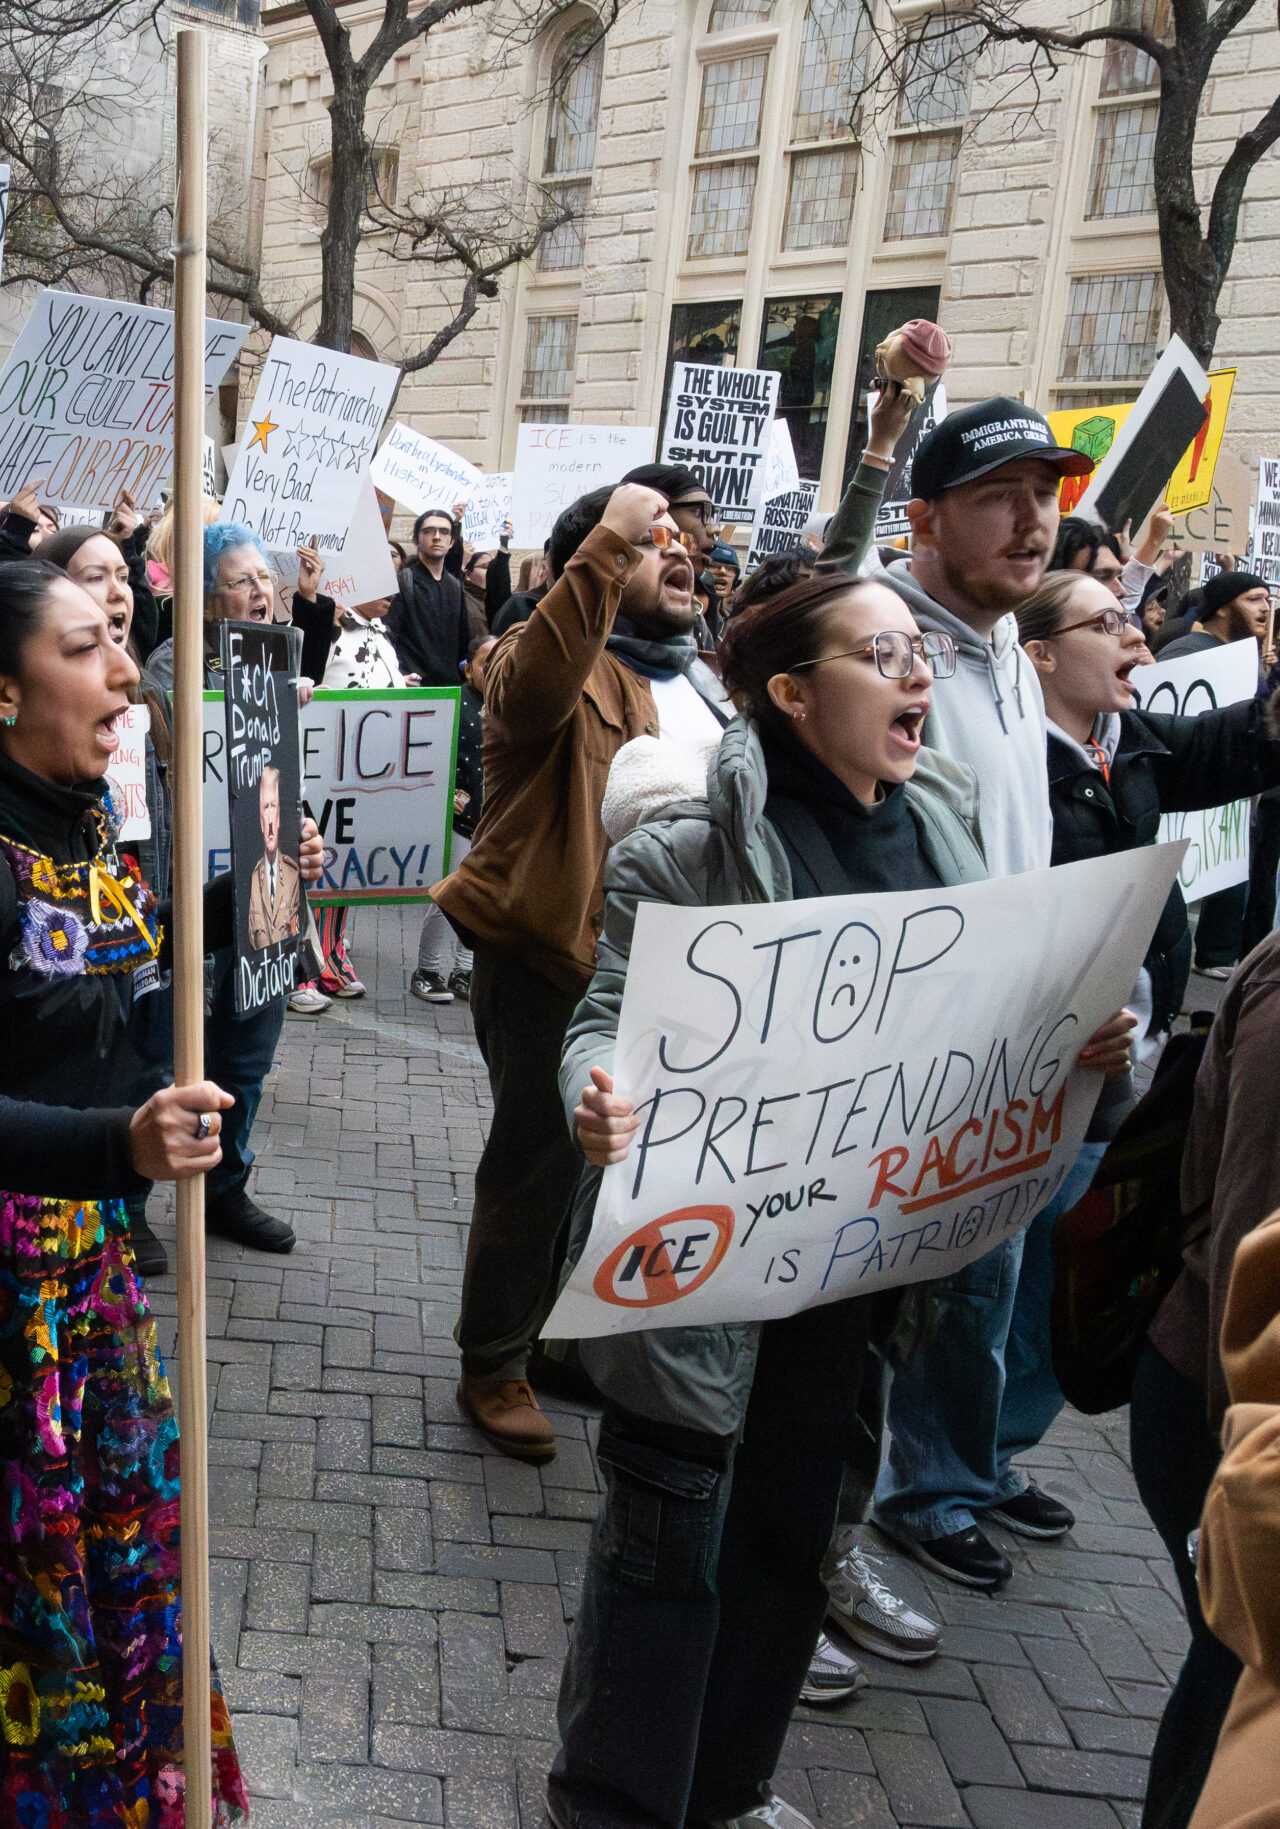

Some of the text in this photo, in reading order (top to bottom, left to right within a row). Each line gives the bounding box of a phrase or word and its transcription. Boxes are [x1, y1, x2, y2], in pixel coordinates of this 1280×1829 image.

[35, 300, 99, 367] YOU
[269, 359, 384, 437] The Patriarchy
[677, 395, 770, 416] SYSTEM
[684, 367, 773, 402] THE WHOLE
[529, 429, 571, 449] ICE
[674, 409, 765, 447] IS GUILTY
[961, 418, 1028, 443] IMMIGRANTS
[973, 431, 1023, 452] AMERICA
[45, 435, 112, 503] OUR
[548, 457, 602, 473] modern
[668, 447, 763, 467] SHUT IT
[244, 455, 279, 502] Very
[281, 463, 317, 503] Bad.
[676, 464, 754, 506] OWN!
[258, 507, 286, 544] Not
[763, 508, 789, 528] ROSS
[756, 528, 803, 554] MURDE
[232, 703, 281, 746] Donald
[335, 709, 437, 782] ICE
[239, 942, 297, 1012] Dictator
[659, 905, 965, 1074] STOP
[631, 1012, 1079, 1200] PRETENDING
[740, 1076, 1068, 1248] YOUR RACISM
[618, 1232, 710, 1283] ICE
[764, 1249, 801, 1285] IS
